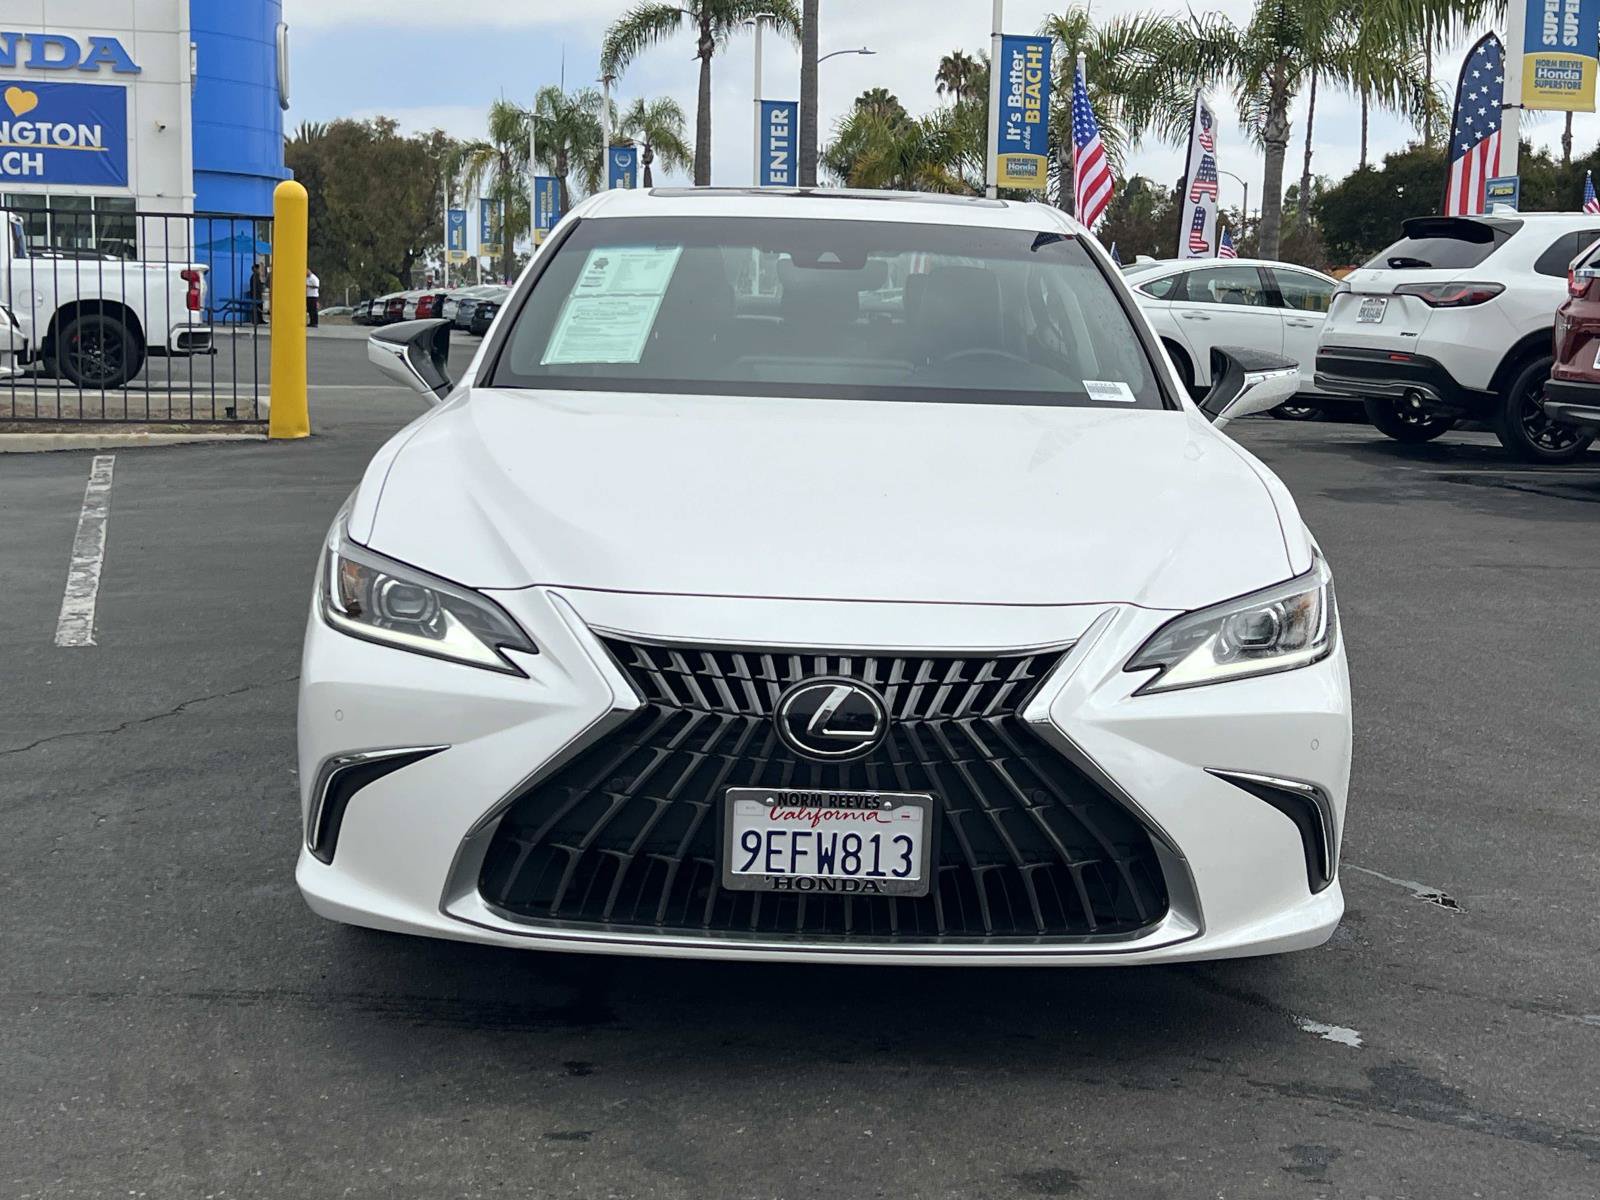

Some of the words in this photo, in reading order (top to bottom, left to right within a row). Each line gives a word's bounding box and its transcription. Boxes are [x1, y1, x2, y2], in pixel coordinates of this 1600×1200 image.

[1542, 0, 1560, 46] SUPE
[1562, 0, 1580, 47] SUPE
[1007, 50, 1024, 107] Better
[1025, 45, 1043, 124] BEACH!
[1534, 80, 1582, 90] SUPERSTORE
[1537, 69, 1580, 80] Honda
[1006, 112, 1022, 140] It's
[0, 151, 44, 176] CH
[770, 108, 789, 184] ENTER
[1187, 106, 1218, 258] SAL
[769, 804, 892, 828] California
[777, 792, 823, 808] NORM
[829, 794, 881, 809] REEVES
[740, 830, 913, 877] 9EFW813
[772, 876, 883, 893] HONDA
